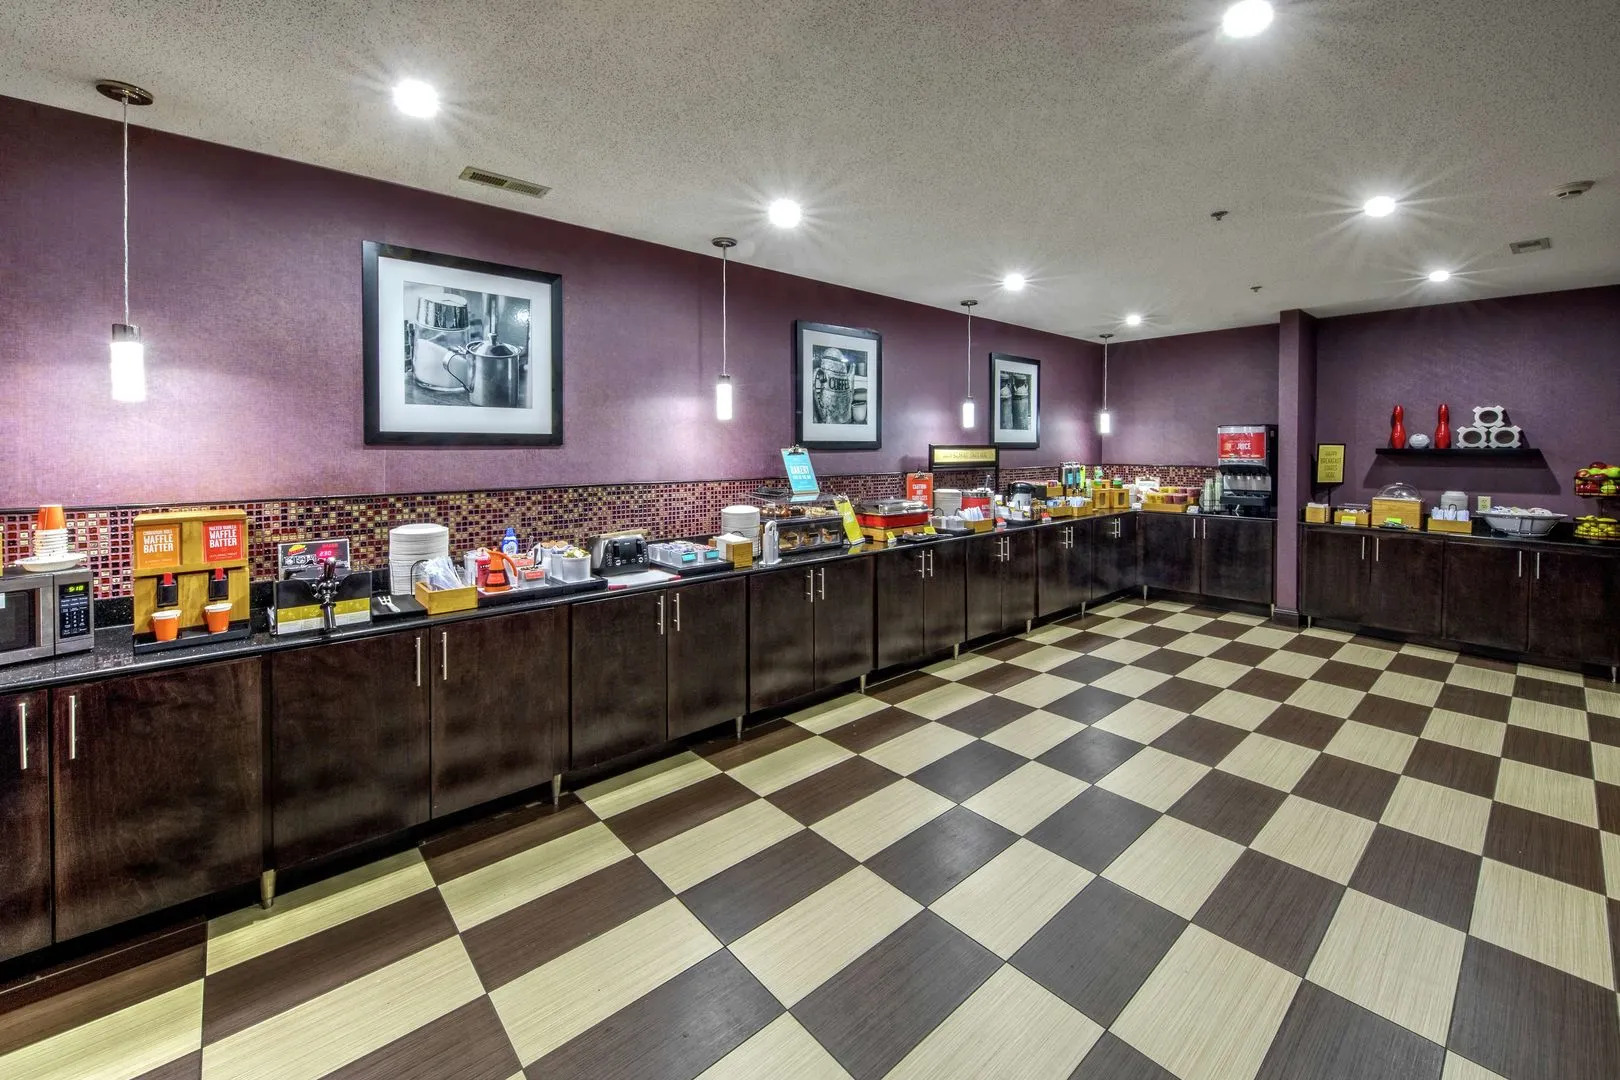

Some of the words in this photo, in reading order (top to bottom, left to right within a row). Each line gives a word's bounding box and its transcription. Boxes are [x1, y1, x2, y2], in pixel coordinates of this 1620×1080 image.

[1237, 442, 1251, 450] JUICE
[143, 533, 174, 545] WAFFLE
[209, 529, 237, 540] WAFFLE
[143, 543, 174, 554] BATTER
[209, 538, 237, 548] BATTER
